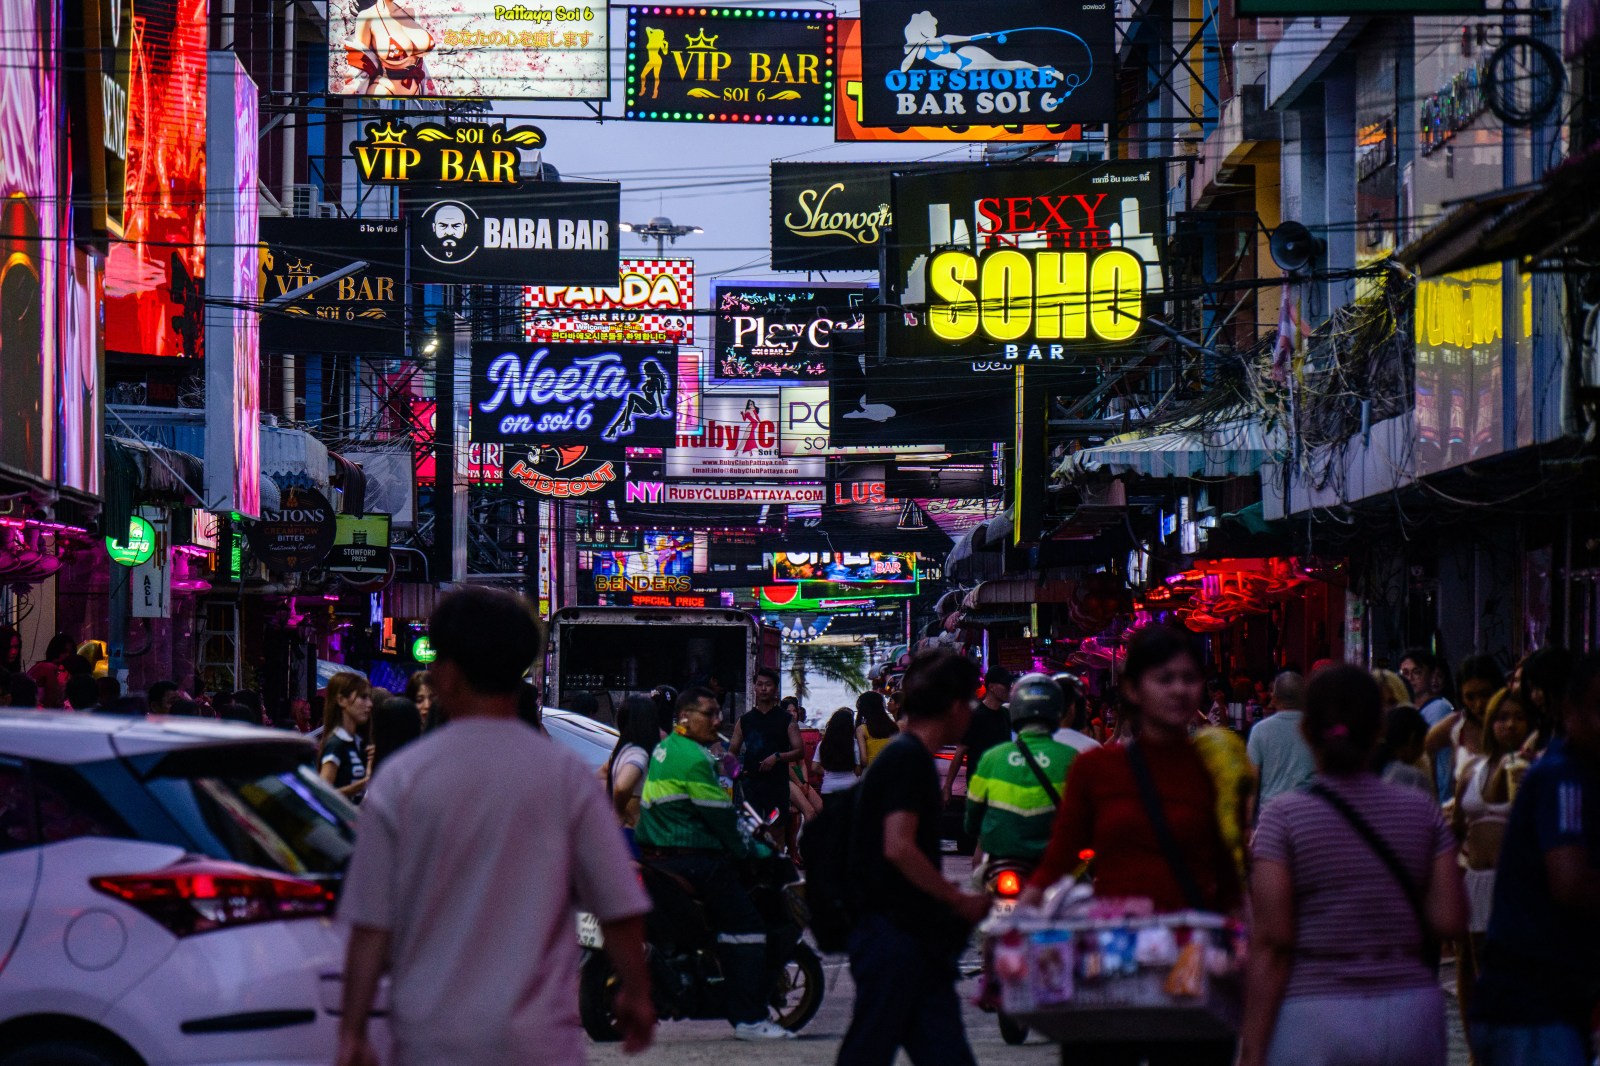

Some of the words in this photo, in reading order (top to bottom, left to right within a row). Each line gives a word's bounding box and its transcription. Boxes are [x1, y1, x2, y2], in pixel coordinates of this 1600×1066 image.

[493, 4, 552, 24] Pattaya
[555, 6, 581, 21] Soi
[583, 6, 595, 21] 6
[671, 50, 732, 82] VIP
[748, 52, 821, 84] BAR
[885, 67, 1058, 92] OFFSHORE
[723, 87, 749, 102] SOI
[756, 88, 766, 102] 6
[896, 91, 967, 115] BAR
[976, 90, 1031, 114] SOI
[1040, 92, 1060, 112] 6
[456, 128, 485, 144] SOI
[492, 128, 502, 144] 6
[356, 146, 421, 181] VIP
[440, 149, 518, 184] BAR
[976, 193, 1108, 235] SEXY
[483, 217, 553, 250] BABA
[557, 219, 609, 250] BAR
[338, 276, 395, 302] BAR
[544, 273, 681, 306] PANDA
[930, 250, 1143, 340] SOHO
[316, 306, 340, 320] SOI
[345, 307, 355, 321] 6
[1005, 343, 1065, 360] BAR
[480, 347, 632, 411] Neeta
[500, 412, 535, 434] on
[537, 407, 574, 432] soi
[574, 403, 595, 430] 6
[509, 461, 617, 498] HIDEOUT
[669, 488, 824, 501] RUBYCLUBPATTAYA.COM
[834, 482, 900, 504] LUS
[111, 539, 150, 553] Cang
[343, 548, 376, 557] STOWFORD
[875, 562, 902, 574] BAR
[594, 575, 691, 592] BENDERS
[631, 595, 672, 606] SPECIAL
[675, 596, 705, 607] PRICE
